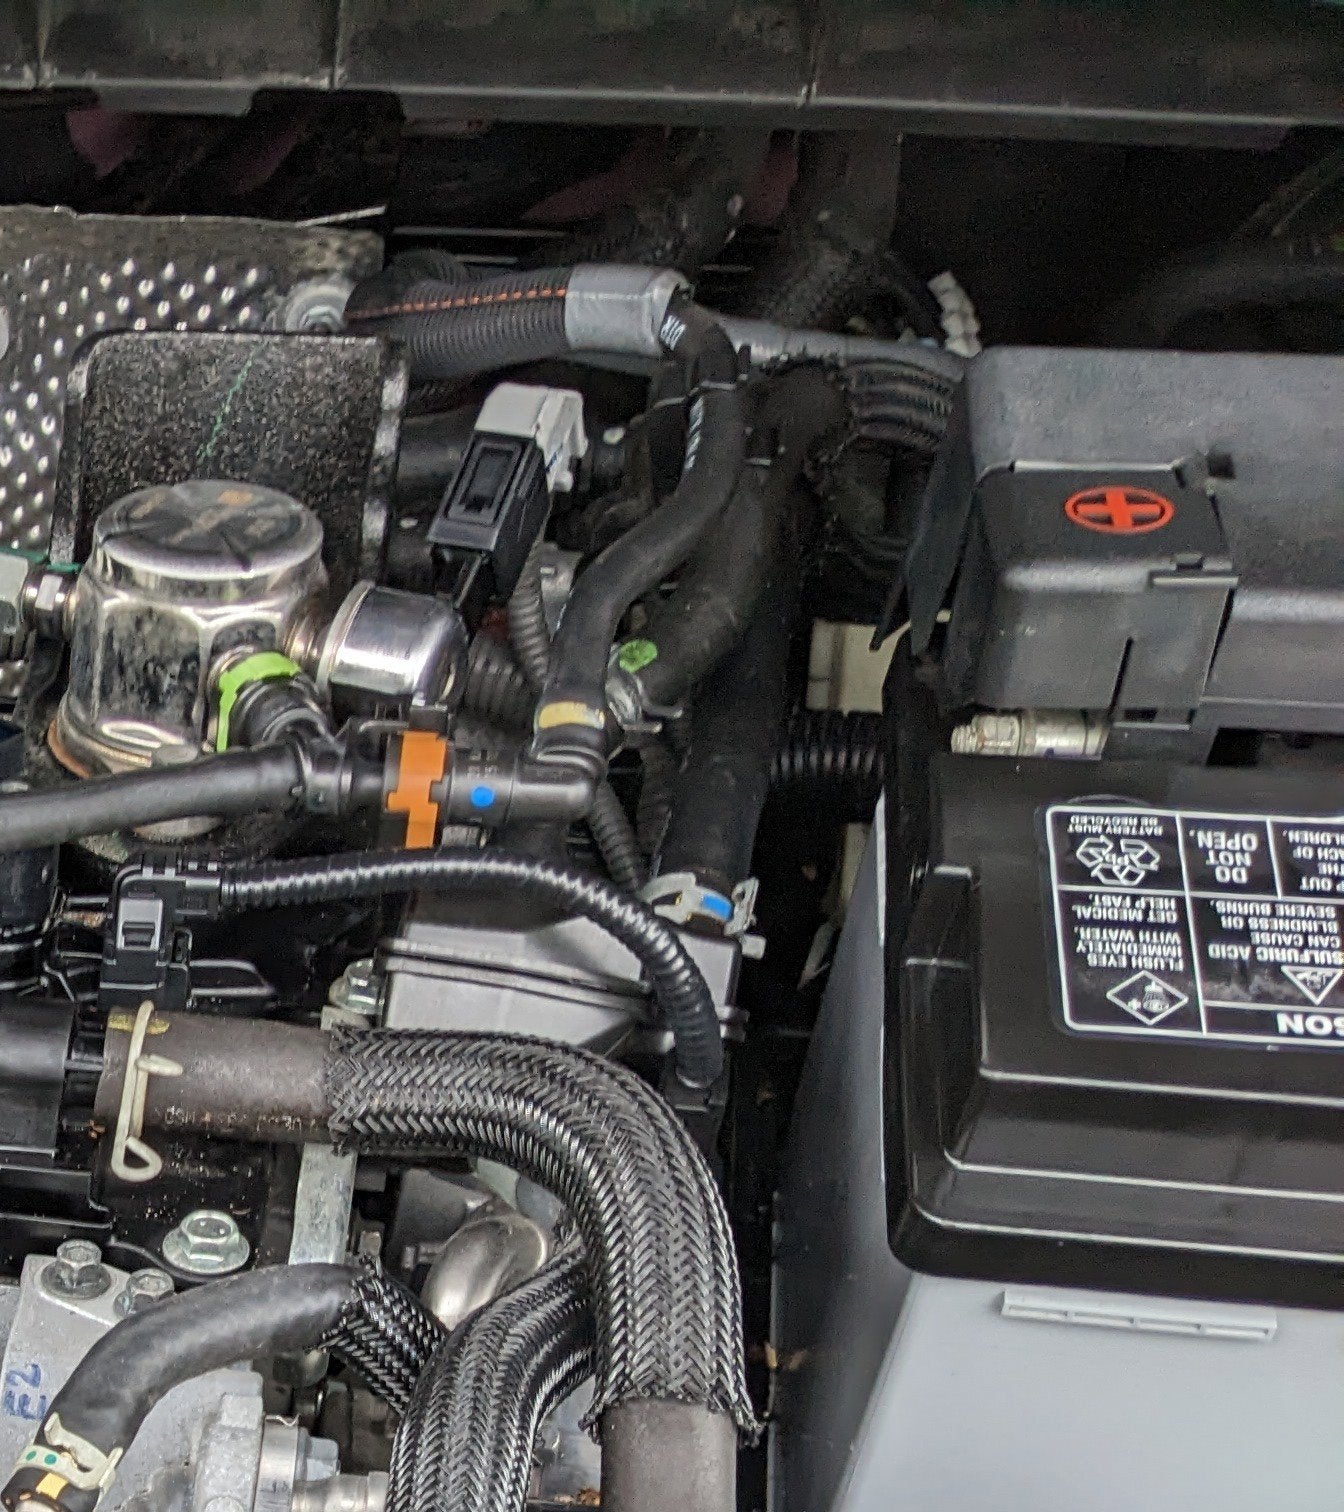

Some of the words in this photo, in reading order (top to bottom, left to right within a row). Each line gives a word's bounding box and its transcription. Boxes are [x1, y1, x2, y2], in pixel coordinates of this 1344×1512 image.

[1067, 824, 1104, 835] MUST
[1205, 850, 1252, 867] NOT
[1292, 846, 1313, 860] OF
[1214, 866, 1249, 884] DO
[1299, 875, 1333, 891] OUT
[1134, 896, 1176, 910] HELP
[1274, 903, 1336, 919] SEVERE
[1071, 904, 1144, 922] MEDICAL
[1147, 909, 1178, 924] GET
[1220, 915, 1245, 930] OR
[1247, 916, 1338, 934] BLINDNESS
[1138, 929, 1181, 944] WITH
[1250, 931, 1304, 947] CAUSE
[1307, 933, 1341, 949] CAN
[1075, 940, 1182, 958] IMMEDIATELY
[1208, 943, 1251, 961] ACID
[1255, 946, 1344, 966] SULFURIC
[1086, 952, 1127, 968] EYES
[1131, 958, 1184, 972] FLUSH
